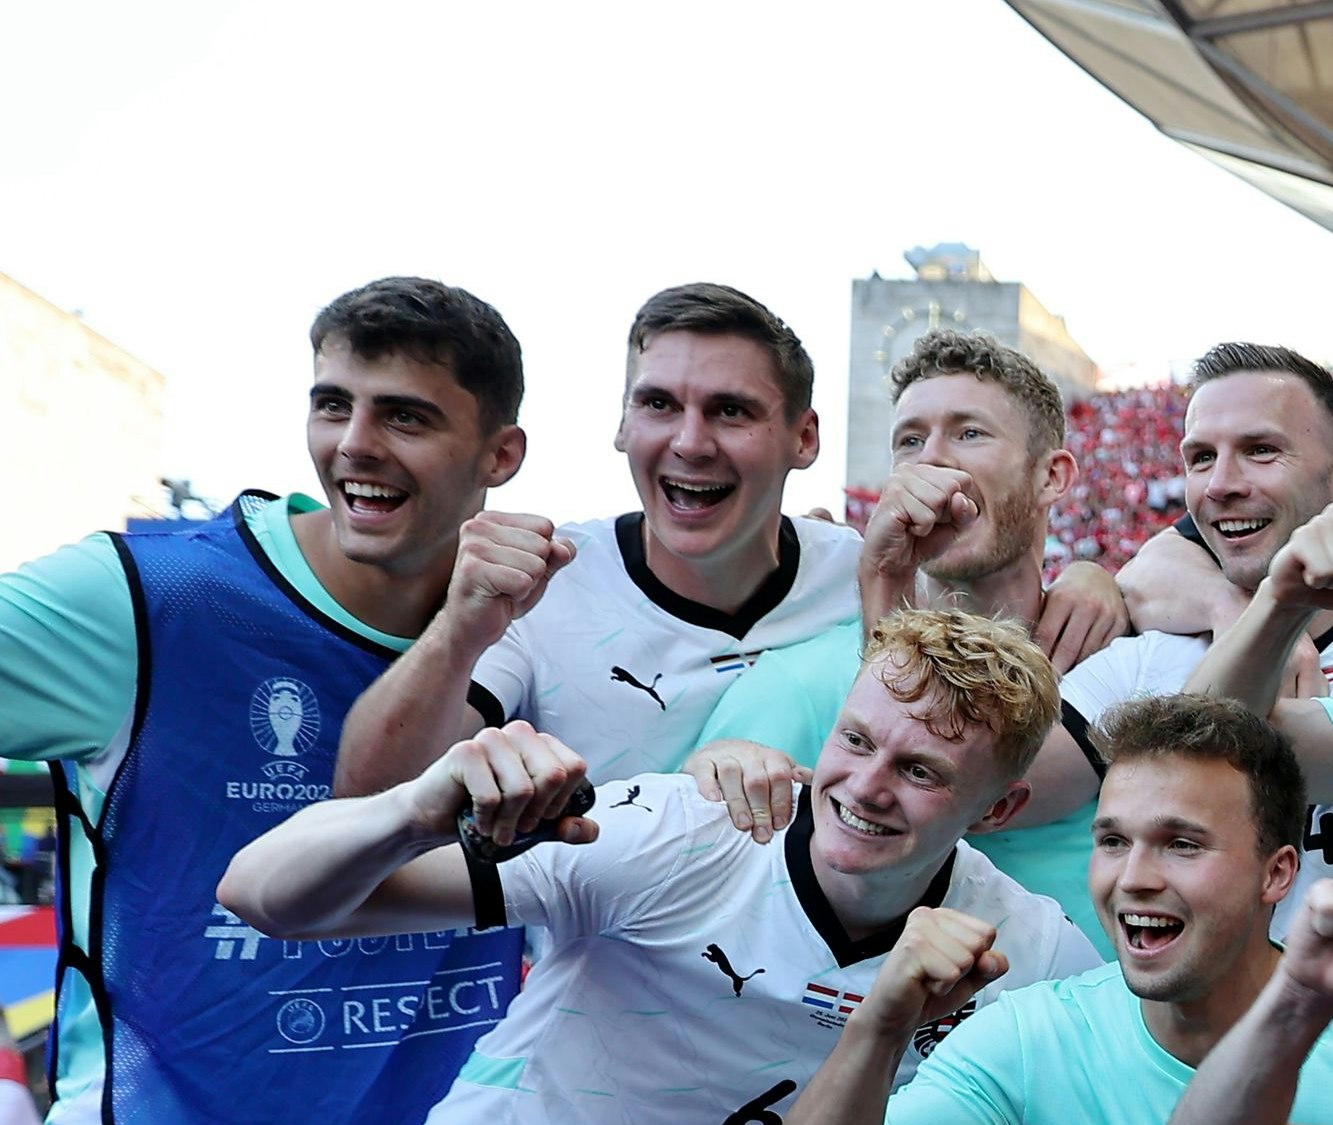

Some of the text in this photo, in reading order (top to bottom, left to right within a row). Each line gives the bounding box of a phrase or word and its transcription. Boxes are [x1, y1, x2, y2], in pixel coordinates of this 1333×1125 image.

[262, 763, 306, 780] UEFA
[226, 781, 332, 801] EURO202
[343, 976, 504, 1036] RESECT
